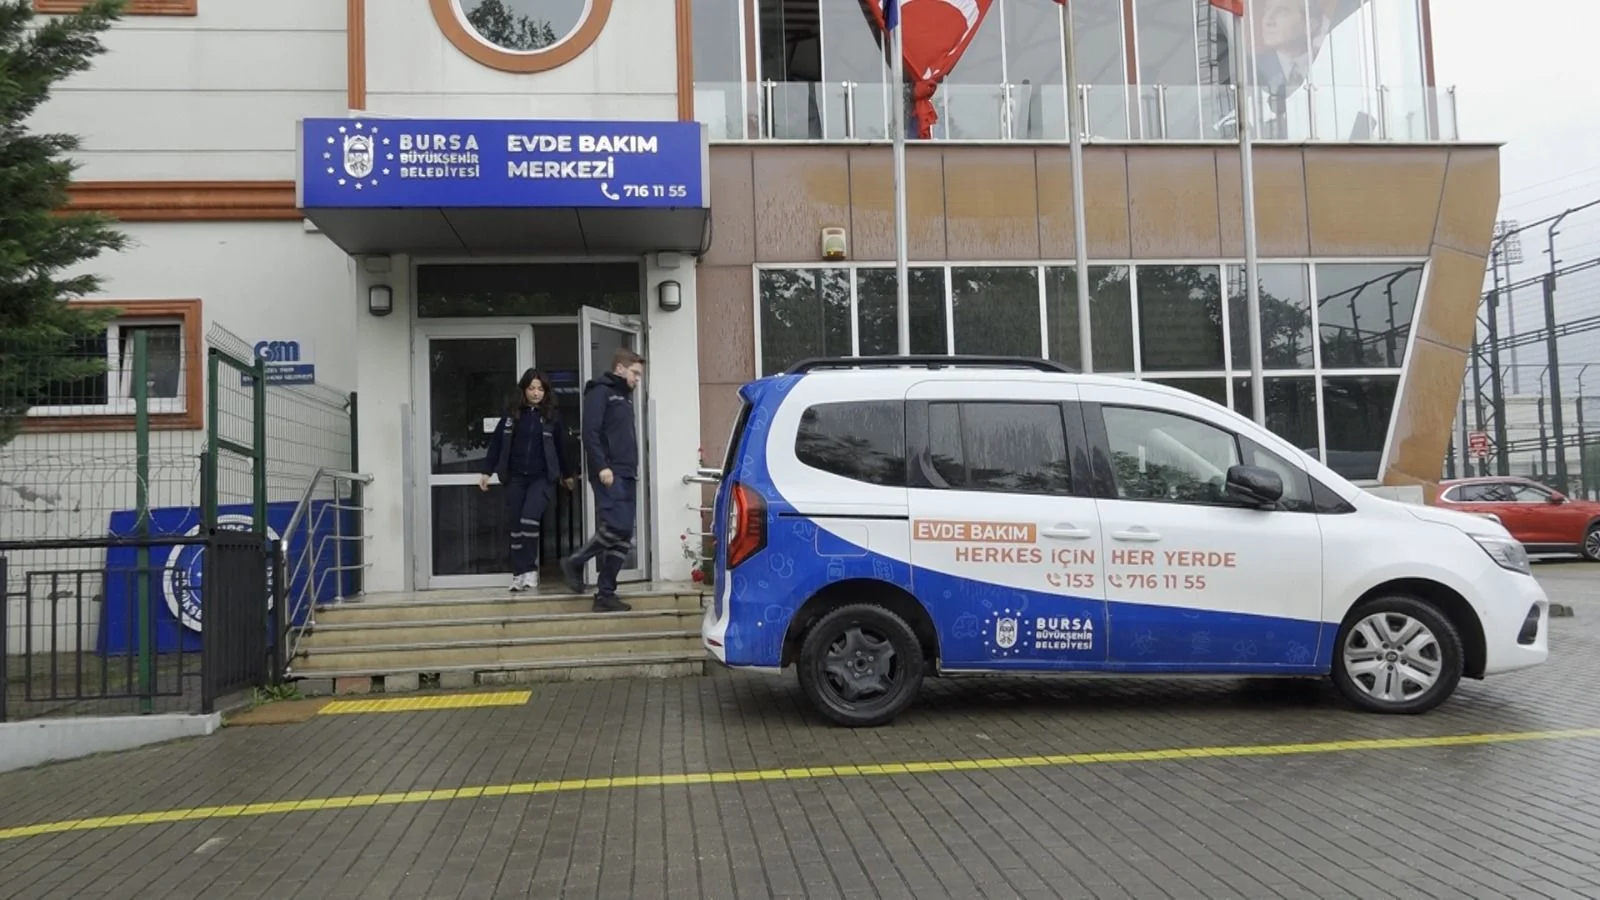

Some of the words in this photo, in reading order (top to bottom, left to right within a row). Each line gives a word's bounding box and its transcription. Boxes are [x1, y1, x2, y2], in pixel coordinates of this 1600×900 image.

[400, 134, 479, 150] BURSA
[507, 134, 572, 152] EVDE
[579, 135, 657, 153] BAKIM
[400, 151, 479, 164] BÜYÜKŞEHİR
[400, 164, 480, 178] BELEDİYESİ
[507, 156, 614, 179] MERKEZİ
[623, 184, 648, 198] 716
[652, 184, 665, 198] 11
[668, 185, 687, 198] 55
[918, 523, 965, 540] EVDE
[971, 524, 1029, 542] BAKIM
[955, 547, 1043, 564] HERKES
[1051, 548, 1095, 567] İÇİN
[1112, 550, 1155, 566] HER
[1163, 551, 1237, 568] YERDE
[1065, 574, 1095, 588] 153
[1126, 574, 1158, 589] 716
[1163, 575, 1177, 590] 11
[1184, 575, 1206, 591] 55
[1036, 617, 1093, 631] BURSA
[1035, 640, 1093, 651] BELEDİYESİ
